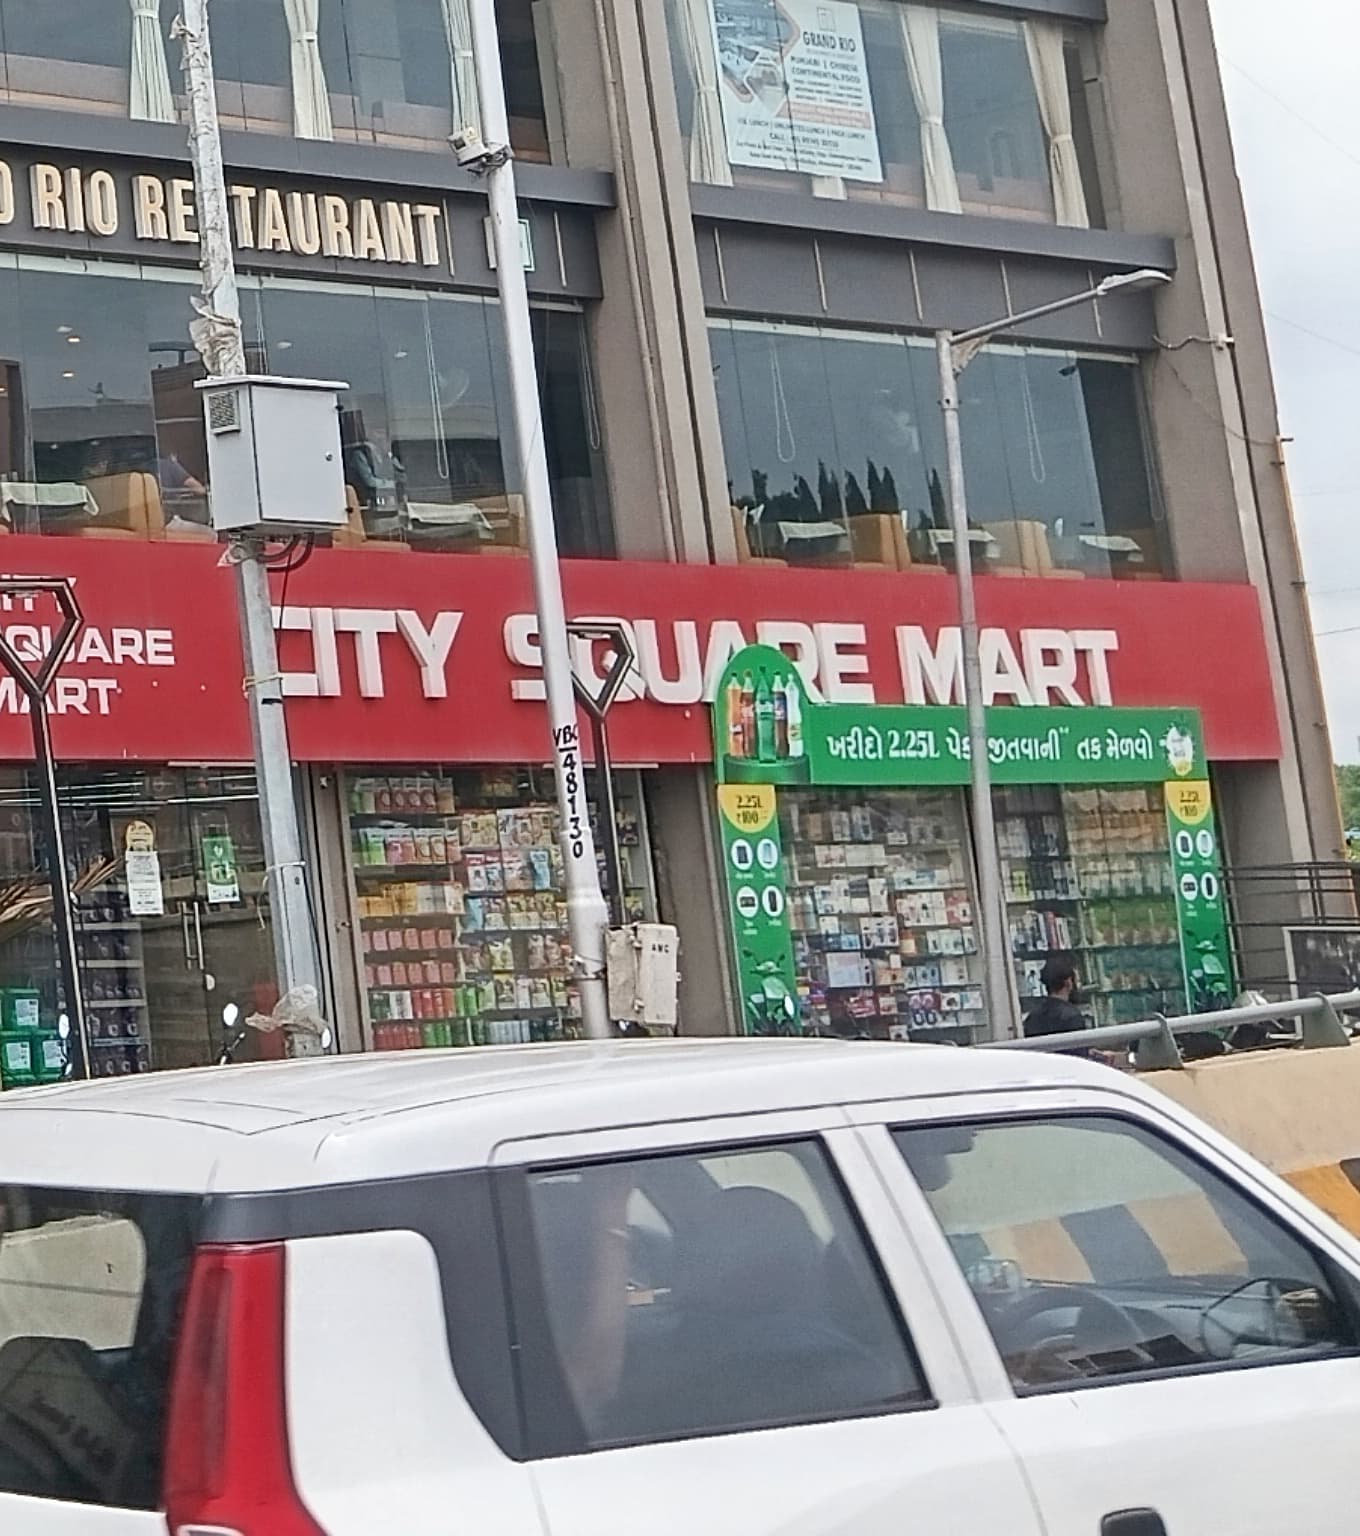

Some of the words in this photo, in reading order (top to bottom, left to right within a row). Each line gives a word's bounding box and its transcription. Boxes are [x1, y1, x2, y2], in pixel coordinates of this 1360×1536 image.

[30, 163, 118, 238] RIO
[136, 173, 442, 268] RETAURANT
[270, 605, 463, 699] CITY
[896, 624, 1119, 707] MART
[826, 727, 883, 759] ખરીદો
[890, 729, 940, 758] 2.25L
